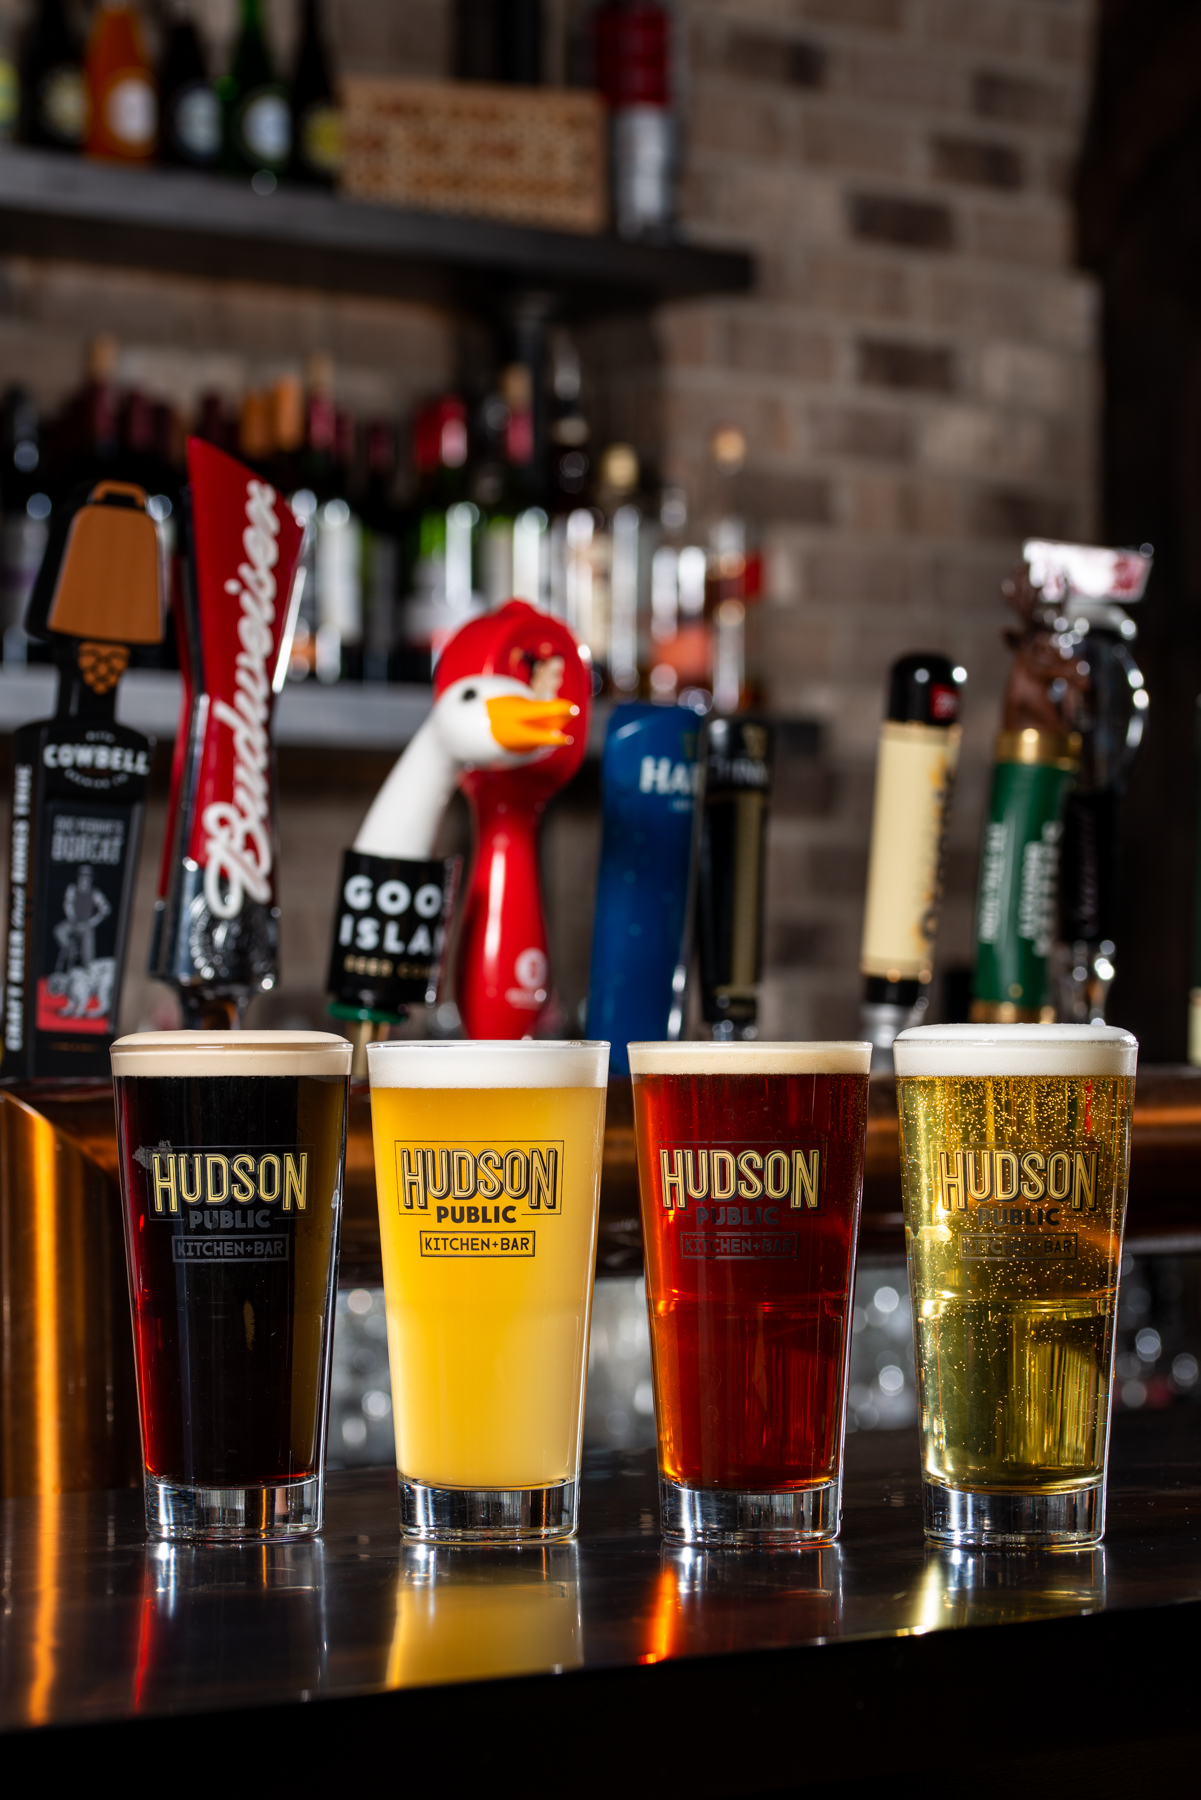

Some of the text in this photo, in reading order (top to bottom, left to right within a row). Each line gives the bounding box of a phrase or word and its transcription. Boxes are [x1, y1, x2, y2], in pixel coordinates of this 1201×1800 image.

[203, 480, 281, 919] Budweiser
[43, 744, 150, 776] COWBELL
[344, 874, 446, 920] GOO
[152, 1152, 309, 1215] HUDSON
[398, 1147, 559, 1209] HUDSON
[659, 1149, 821, 1211] HUDSON
[938, 1150, 1099, 1212] HUDSON
[189, 1209, 271, 1230] PUBLIC
[436, 1205, 517, 1224] PUBLIC
[696, 1206, 780, 1226] PUBLIC
[977, 1207, 1060, 1227] PUBLIC
